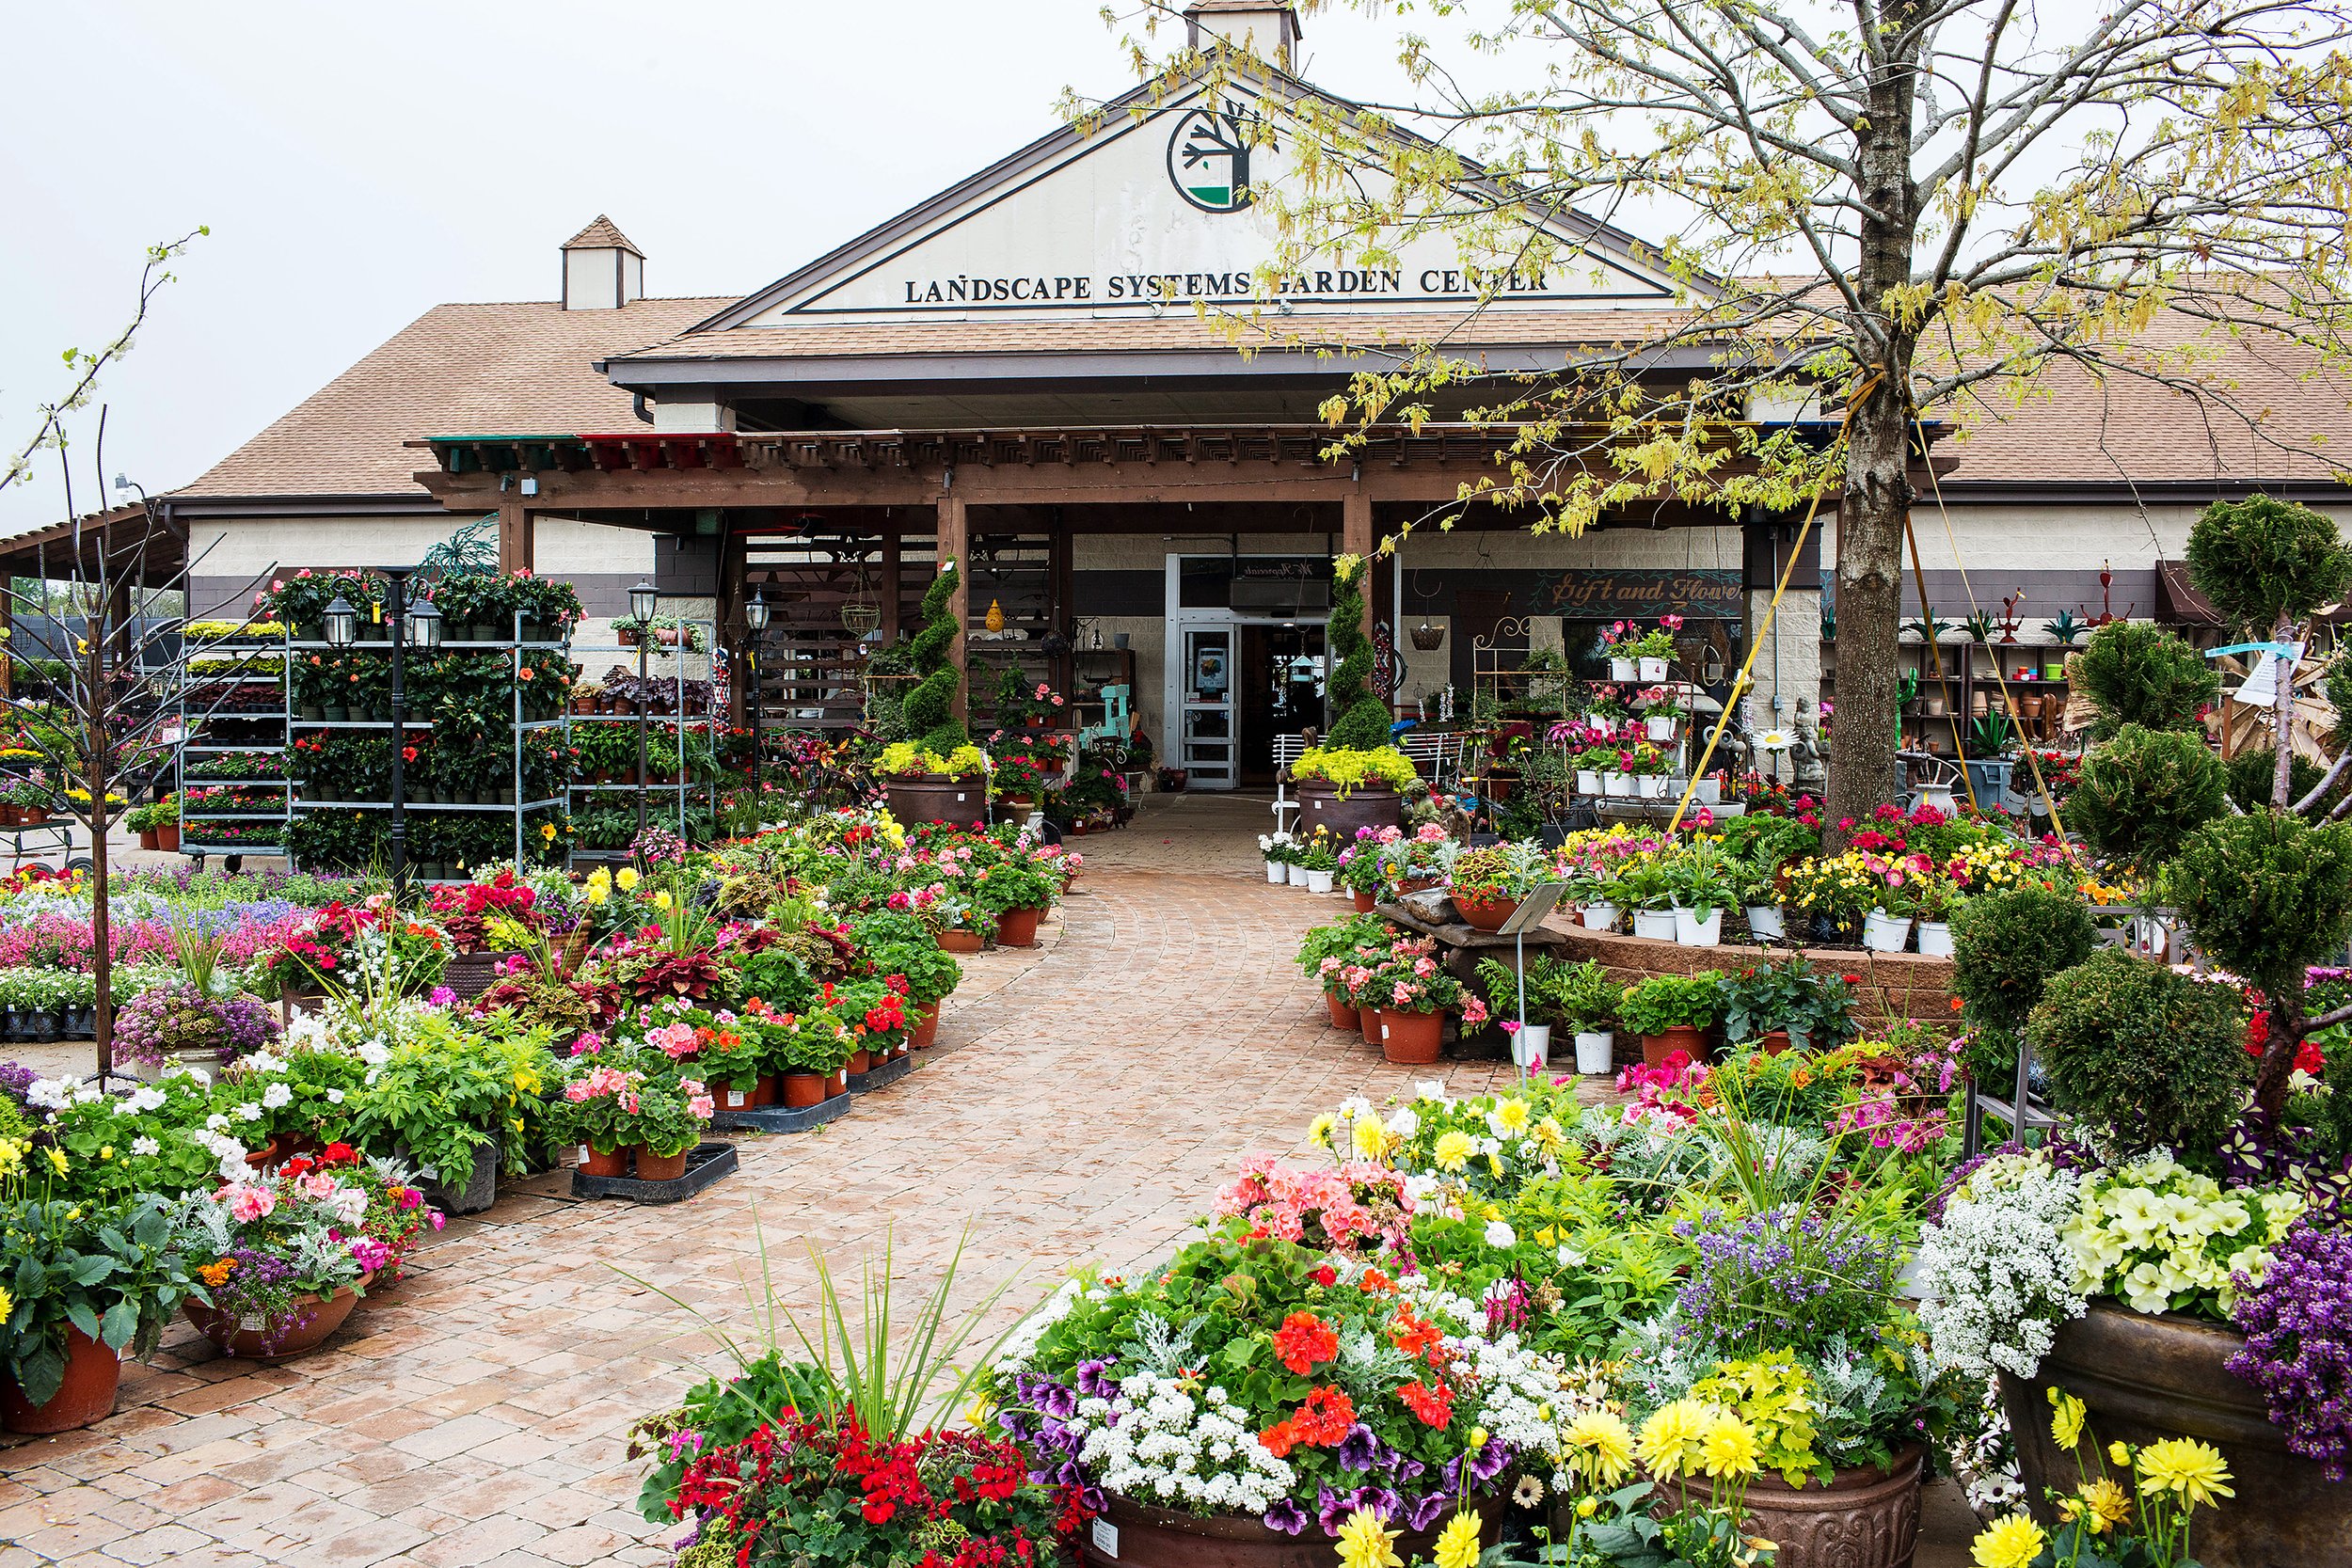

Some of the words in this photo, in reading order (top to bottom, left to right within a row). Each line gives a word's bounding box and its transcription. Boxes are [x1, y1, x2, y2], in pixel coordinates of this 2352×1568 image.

[905, 277, 1091, 303] LANDSCAPE
[1108, 272, 1250, 298] SYSTEMS
[1552, 573, 1613, 607] Gift
[1616, 579, 1664, 600] and
